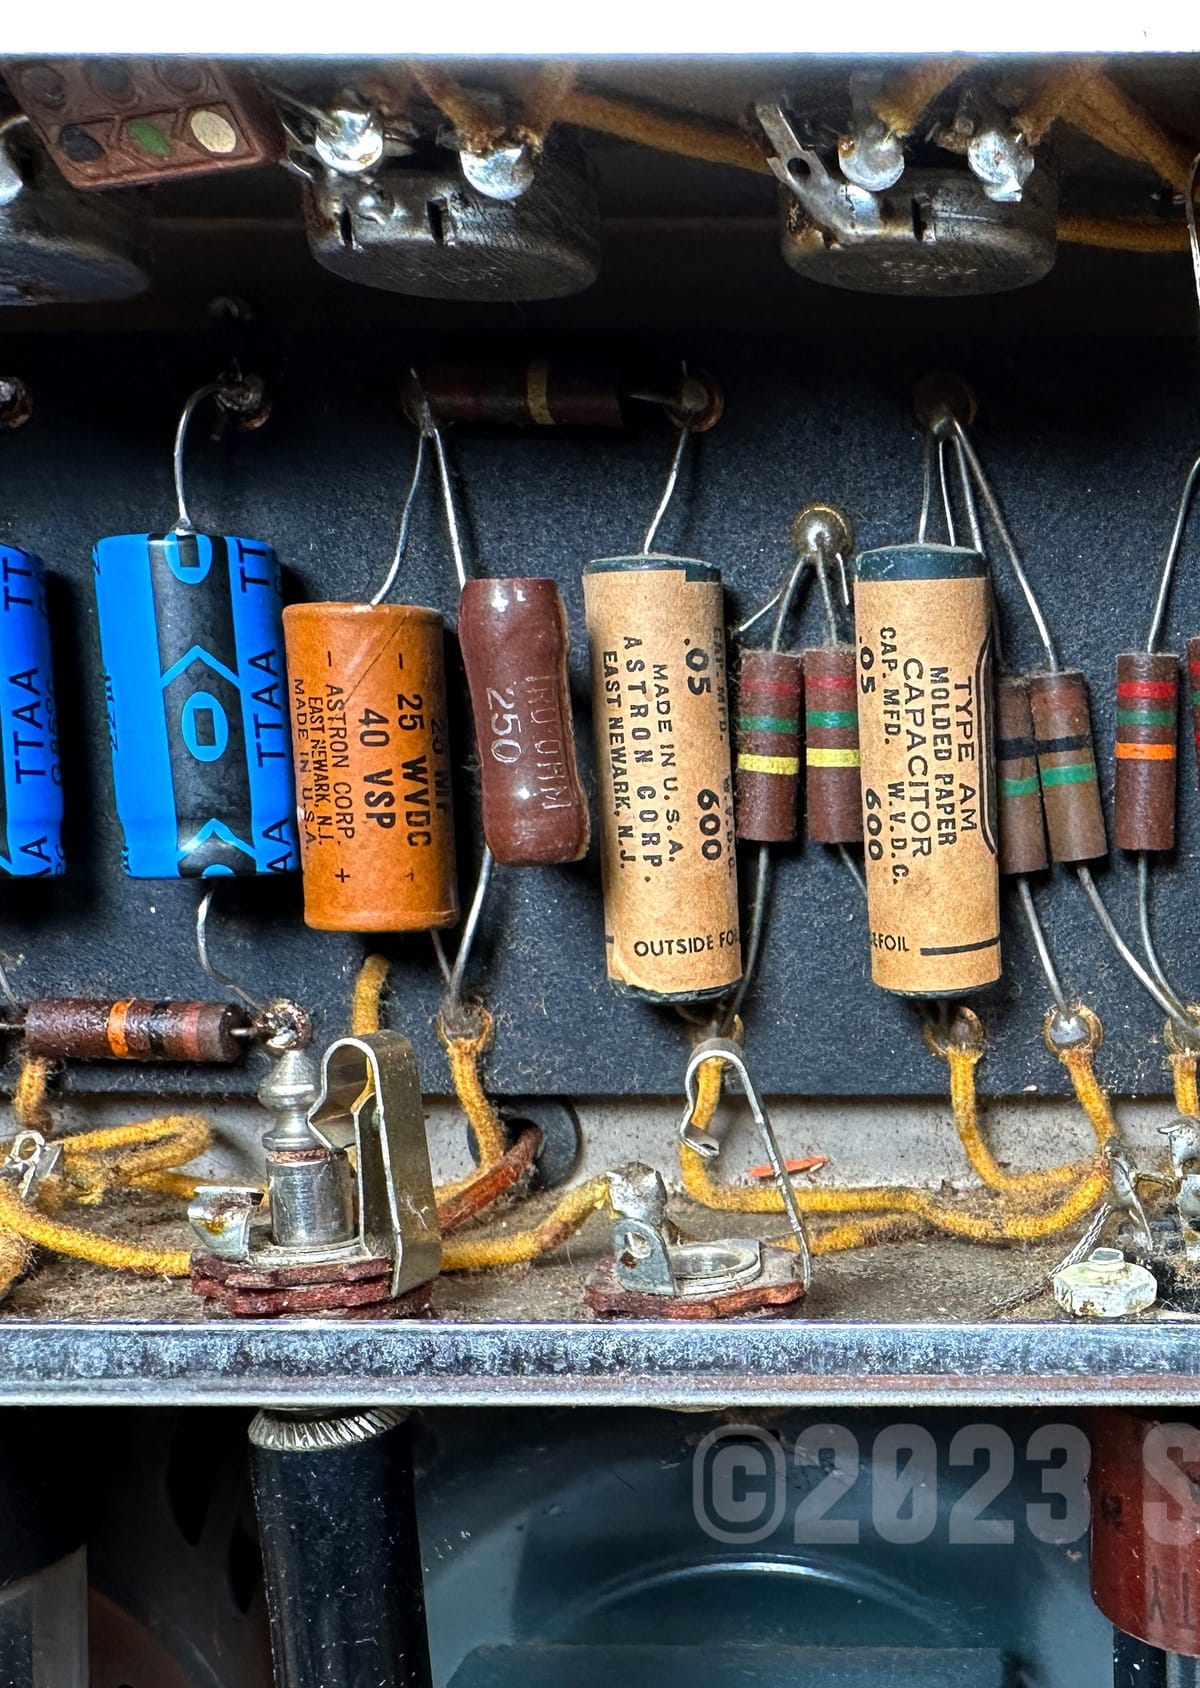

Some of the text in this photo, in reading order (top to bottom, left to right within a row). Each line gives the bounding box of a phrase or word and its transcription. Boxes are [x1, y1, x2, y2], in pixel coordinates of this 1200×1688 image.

[247, 649, 285, 768] TTAA
[294, 679, 308, 740] MADE
[308, 696, 324, 733] EAST
[603, 651, 621, 705] EAST
[652, 664, 673, 732] MADE
[9, 668, 46, 785] TTAA
[299, 752, 311, 773] IN
[325, 684, 349, 768] ASTRON
[486, 688, 521, 763] 250
[661, 744, 675, 767] IN
[903, 658, 932, 857] CAPACITOR
[930, 667, 956, 846] MOLDED PAPER
[954, 679, 978, 832] TYPE AM
[359, 708, 396, 829] 40 VSP
[398, 693, 432, 846] 25 WVDC
[697, 789, 721, 861] 600
[865, 788, 882, 861] 600
[634, 935, 714, 957] OUTSIDE
